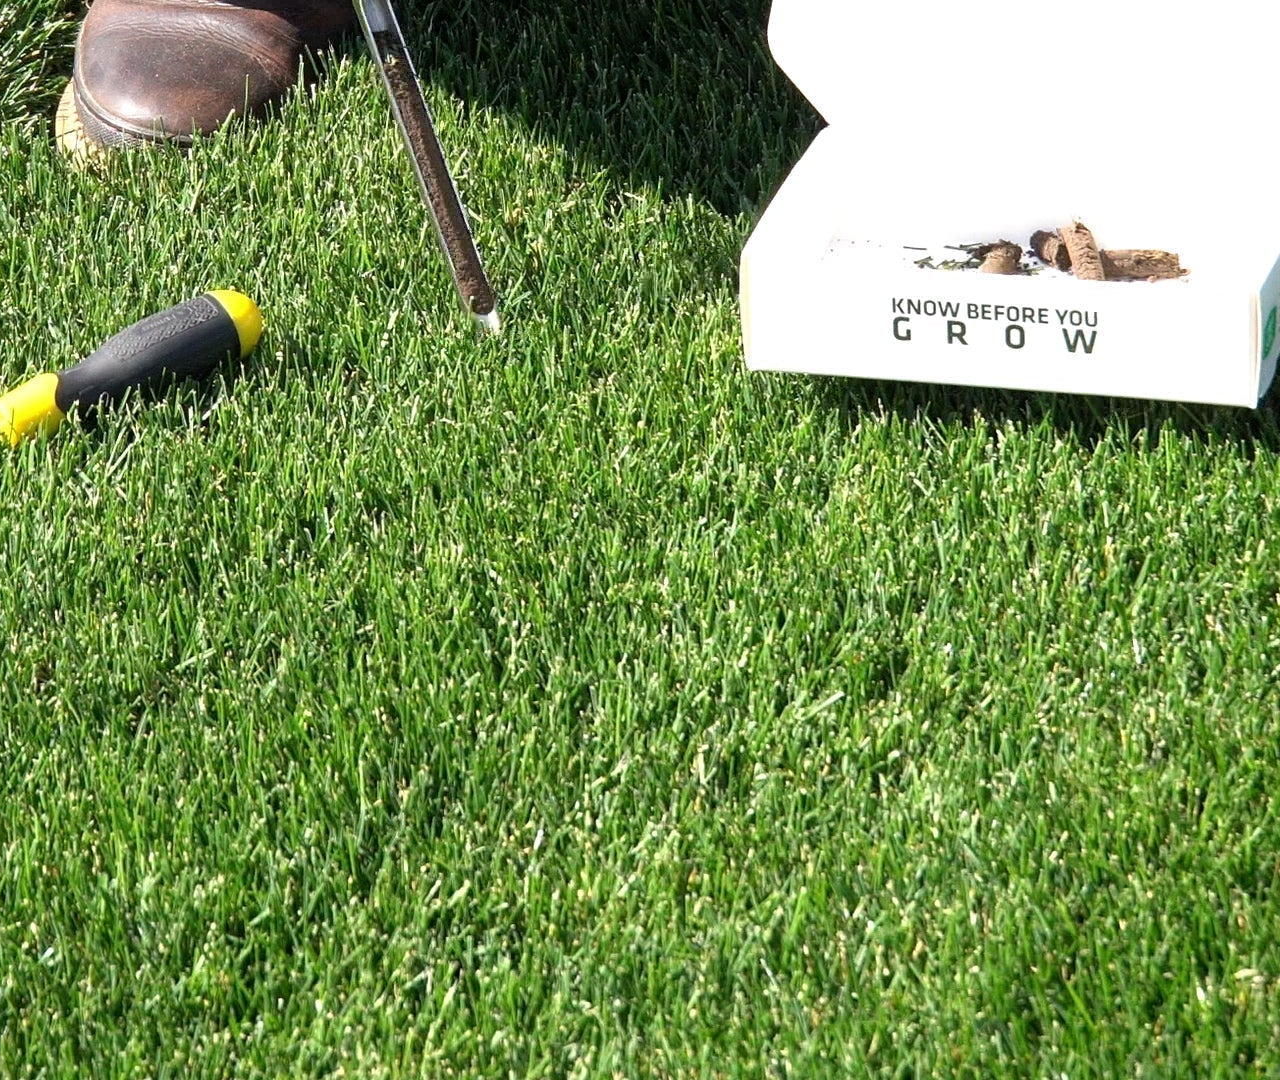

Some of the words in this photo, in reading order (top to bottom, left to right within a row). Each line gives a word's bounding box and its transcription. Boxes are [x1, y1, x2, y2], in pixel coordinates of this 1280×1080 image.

[892, 297, 960, 318] KNOW
[967, 303, 1049, 324] BEFORE
[1056, 309, 1098, 328] YOU
[892, 316, 1097, 354] GROW
